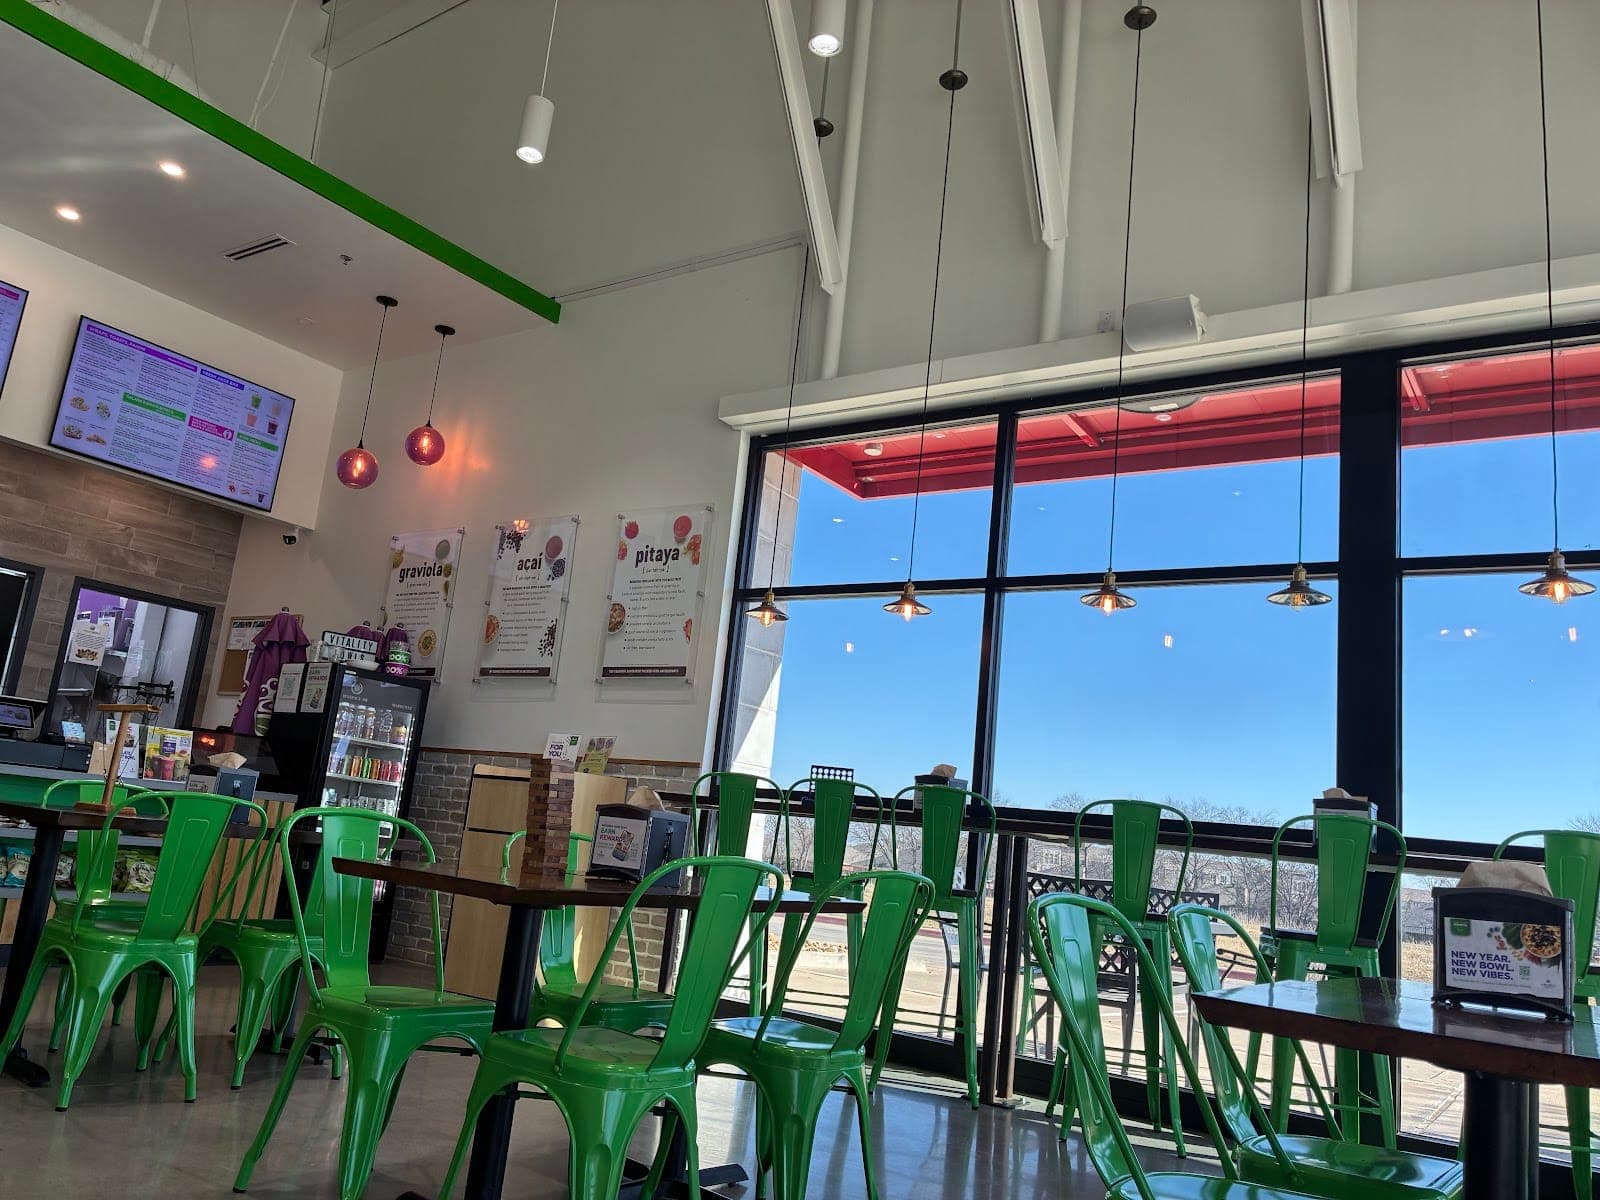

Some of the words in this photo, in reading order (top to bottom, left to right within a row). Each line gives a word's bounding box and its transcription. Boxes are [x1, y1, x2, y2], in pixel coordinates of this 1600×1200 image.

[635, 544, 680, 568] pitaya
[399, 562, 443, 583] graviola
[330, 634, 374, 651] VITALITY
[1451, 950, 1477, 960] NEW
[1479, 952, 1511, 963] YEAR.
[1451, 959, 1477, 968] NEW
[1479, 961, 1515, 972] BOWL.
[1451, 967, 1477, 977] NEW
[1480, 970, 1514, 980] VIBES.
